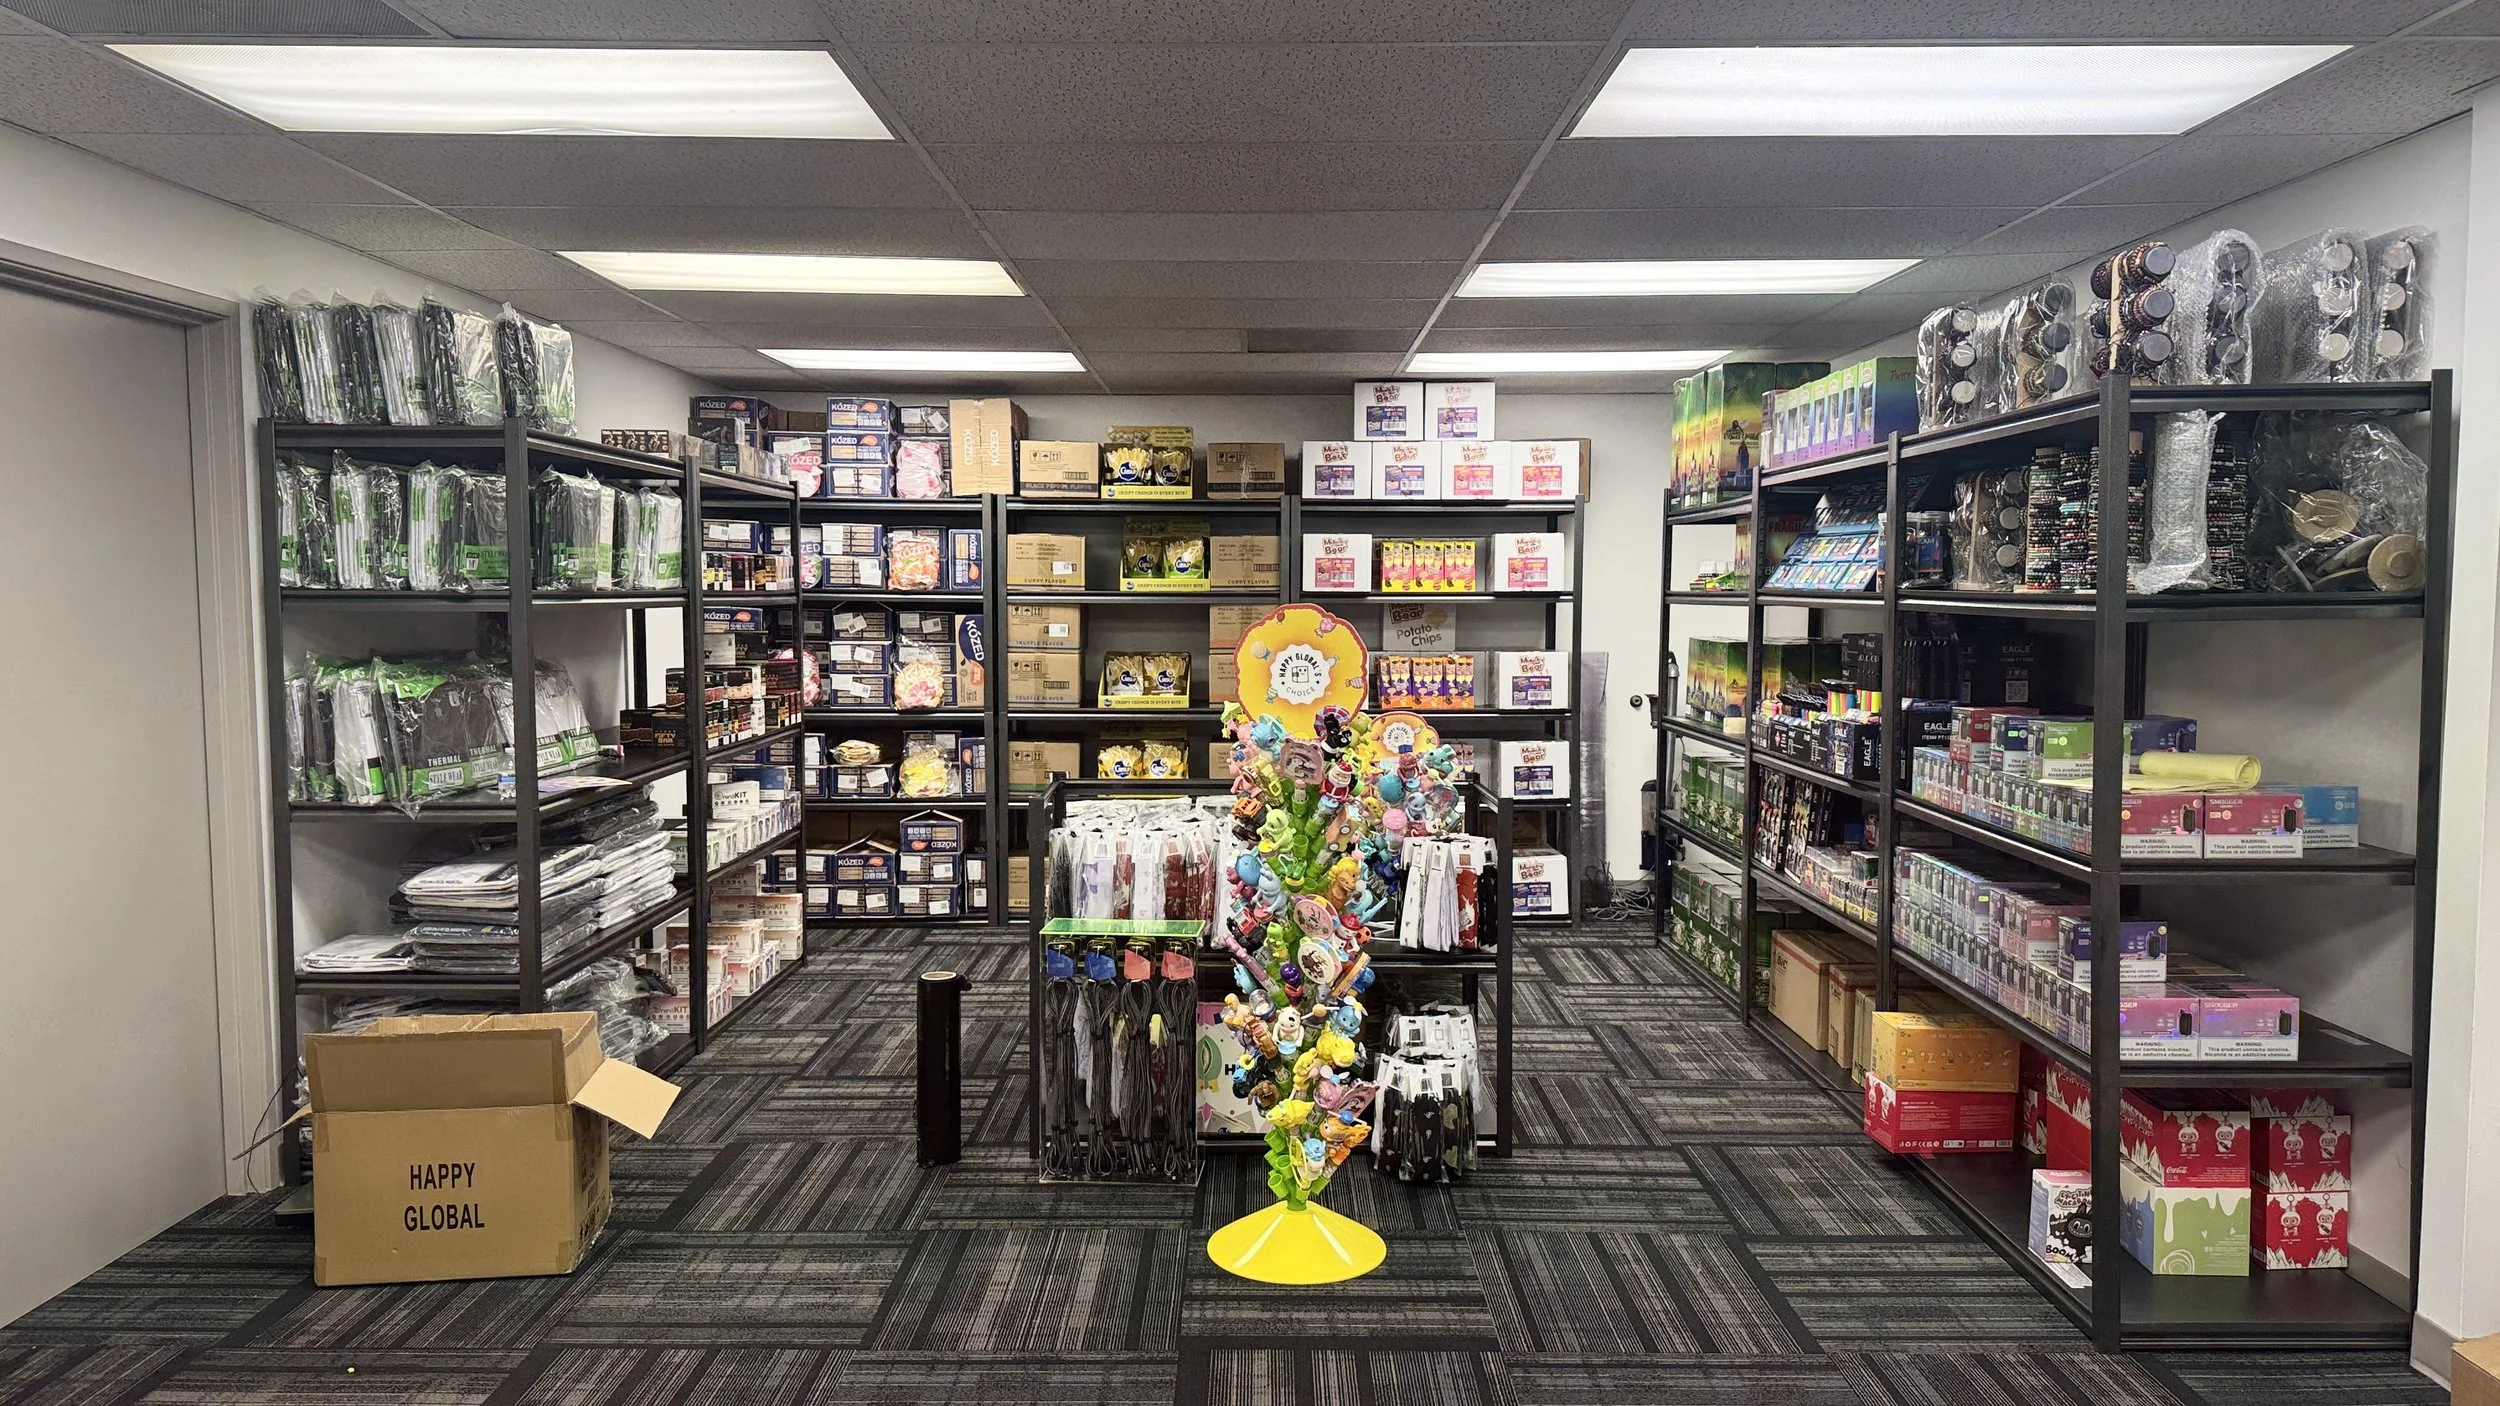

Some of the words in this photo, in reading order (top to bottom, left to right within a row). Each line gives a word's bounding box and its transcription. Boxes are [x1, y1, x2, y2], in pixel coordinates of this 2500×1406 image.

[790, 453, 822, 466] ÓZED
[1392, 608, 1423, 623] Bear
[1396, 623, 1432, 640] Potato
[1411, 632, 1442, 647] Chips
[1279, 655, 1294, 677] HAPPY
[1286, 686, 1316, 697] CHOICE
[428, 754, 462, 767] THERMAL
[430, 770, 448, 784] STYLE
[449, 768, 463, 782] WEAR
[410, 1162, 476, 1190] HAPPY
[404, 1203, 485, 1232] GLOBAL
